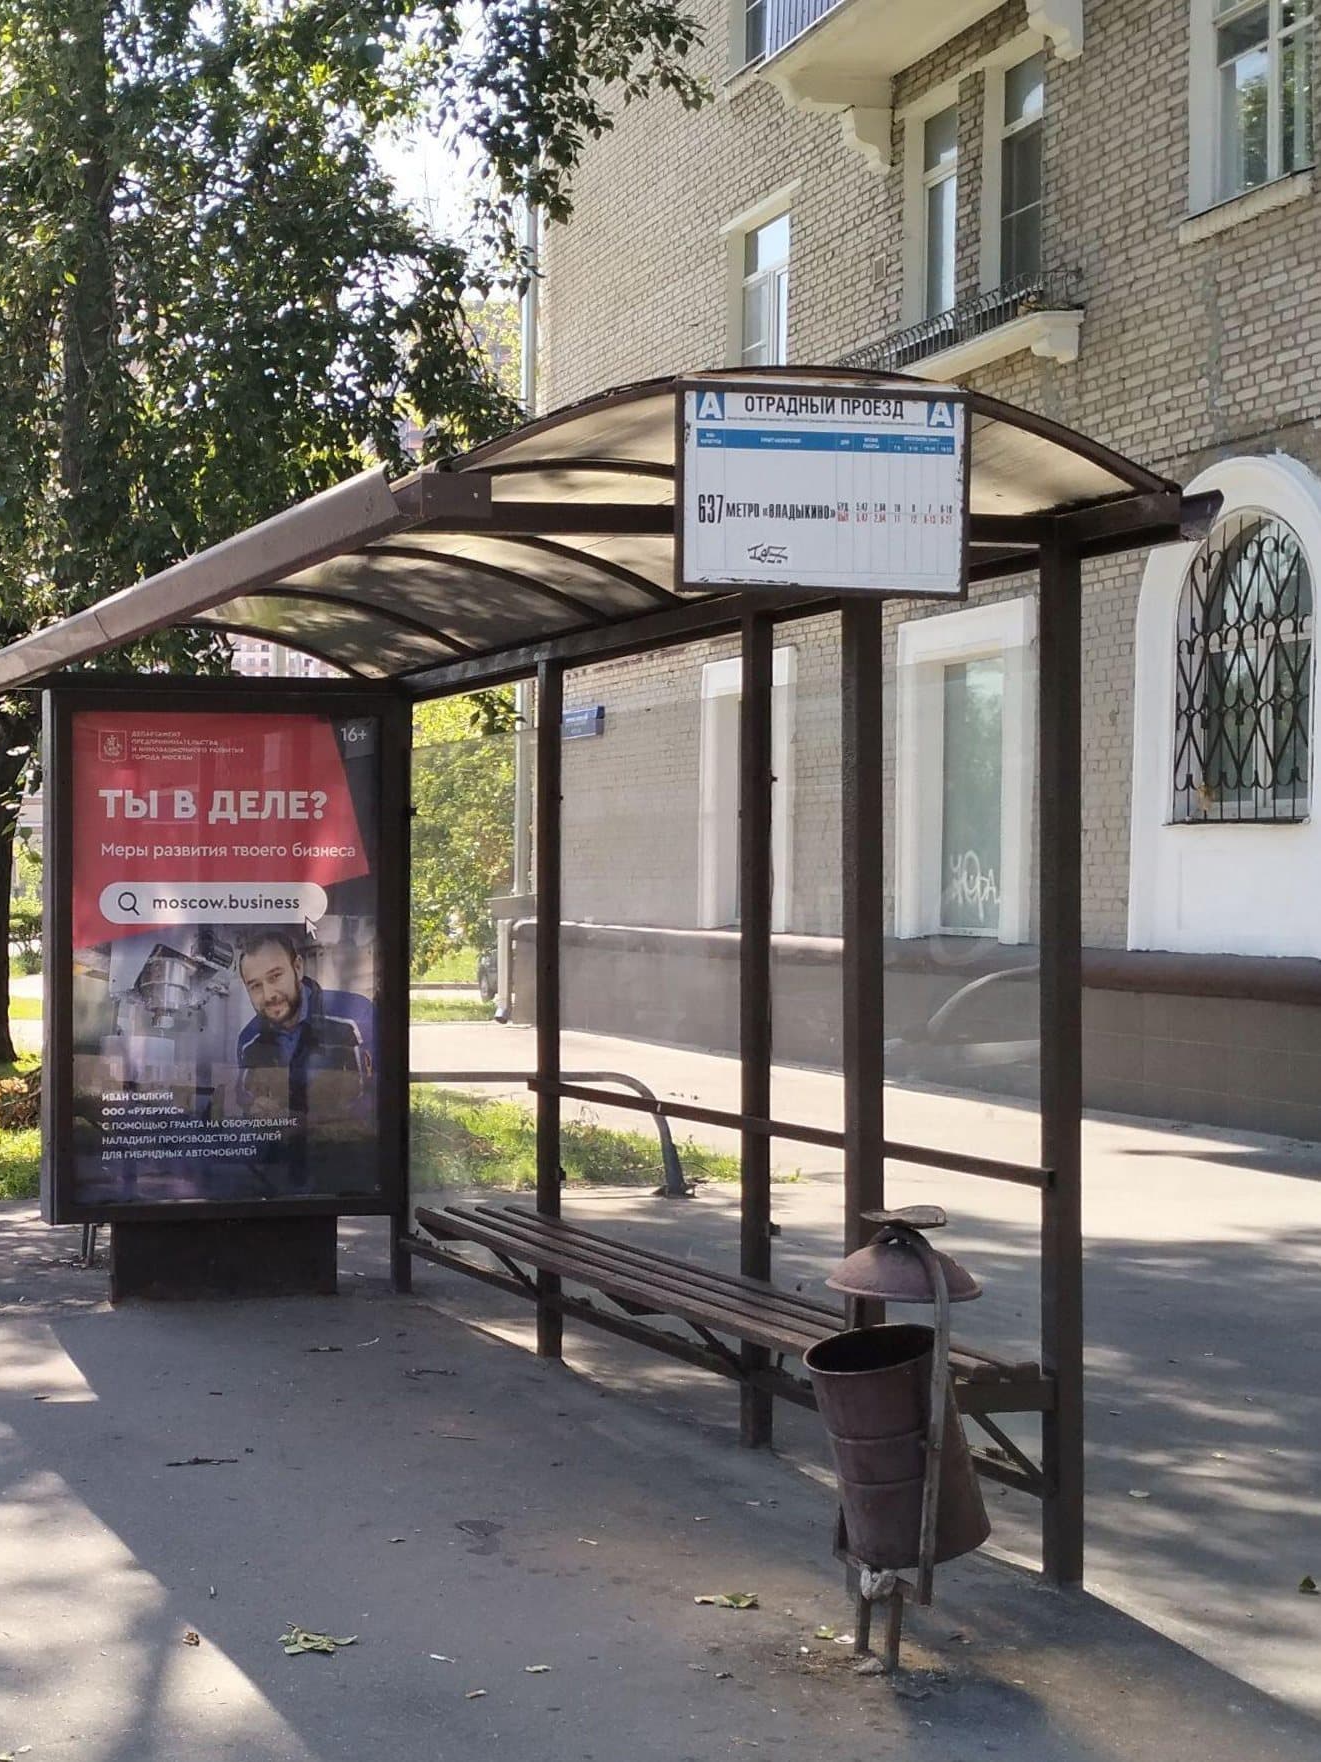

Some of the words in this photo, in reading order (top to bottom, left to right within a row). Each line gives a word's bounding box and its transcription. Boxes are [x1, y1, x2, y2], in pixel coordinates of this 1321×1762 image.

[840, 398, 905, 420] ПРОЕЗД
[698, 494, 724, 524] 637
[726, 502, 760, 518] МЕТРО
[762, 503, 836, 521] «ВЛАДЫКИНО»
[340, 727, 368, 743] 16+
[98, 789, 158, 819] ТЫ
[174, 789, 197, 819] В
[208, 789, 328, 825] ДЕЛЕ?
[101, 843, 148, 860] Меры
[153, 844, 227, 859] развития
[232, 845, 287, 859] твоего
[292, 843, 356, 858] бизнеса
[152, 894, 300, 911] moscow.business
[102, 1092, 128, 1101] ИВАН
[131, 1092, 174, 1101] СИЛКИН
[102, 1107, 126, 1116] ООО
[128, 1106, 184, 1115] «РУБРУКС»
[102, 1122, 110, 1131] С
[111, 1121, 167, 1132] ПОМОЩЬЮ
[169, 1119, 204, 1129] ГРАНТА
[206, 1119, 220, 1129] НА
[221, 1117, 297, 1129] ОБОРУДОВАНИЕ
[102, 1135, 157, 1146] НАЛАДИЛИ
[158, 1133, 238, 1145] ПРОИЗВОДСТВО
[239, 1130, 282, 1142] ДЕТАЛЕЙ
[102, 1150, 122, 1161] ДЛЯ
[124, 1149, 183, 1160] ГИБРИДНЫХ
[185, 1145, 257, 1157] АВТОМОБИЛЕЙ
